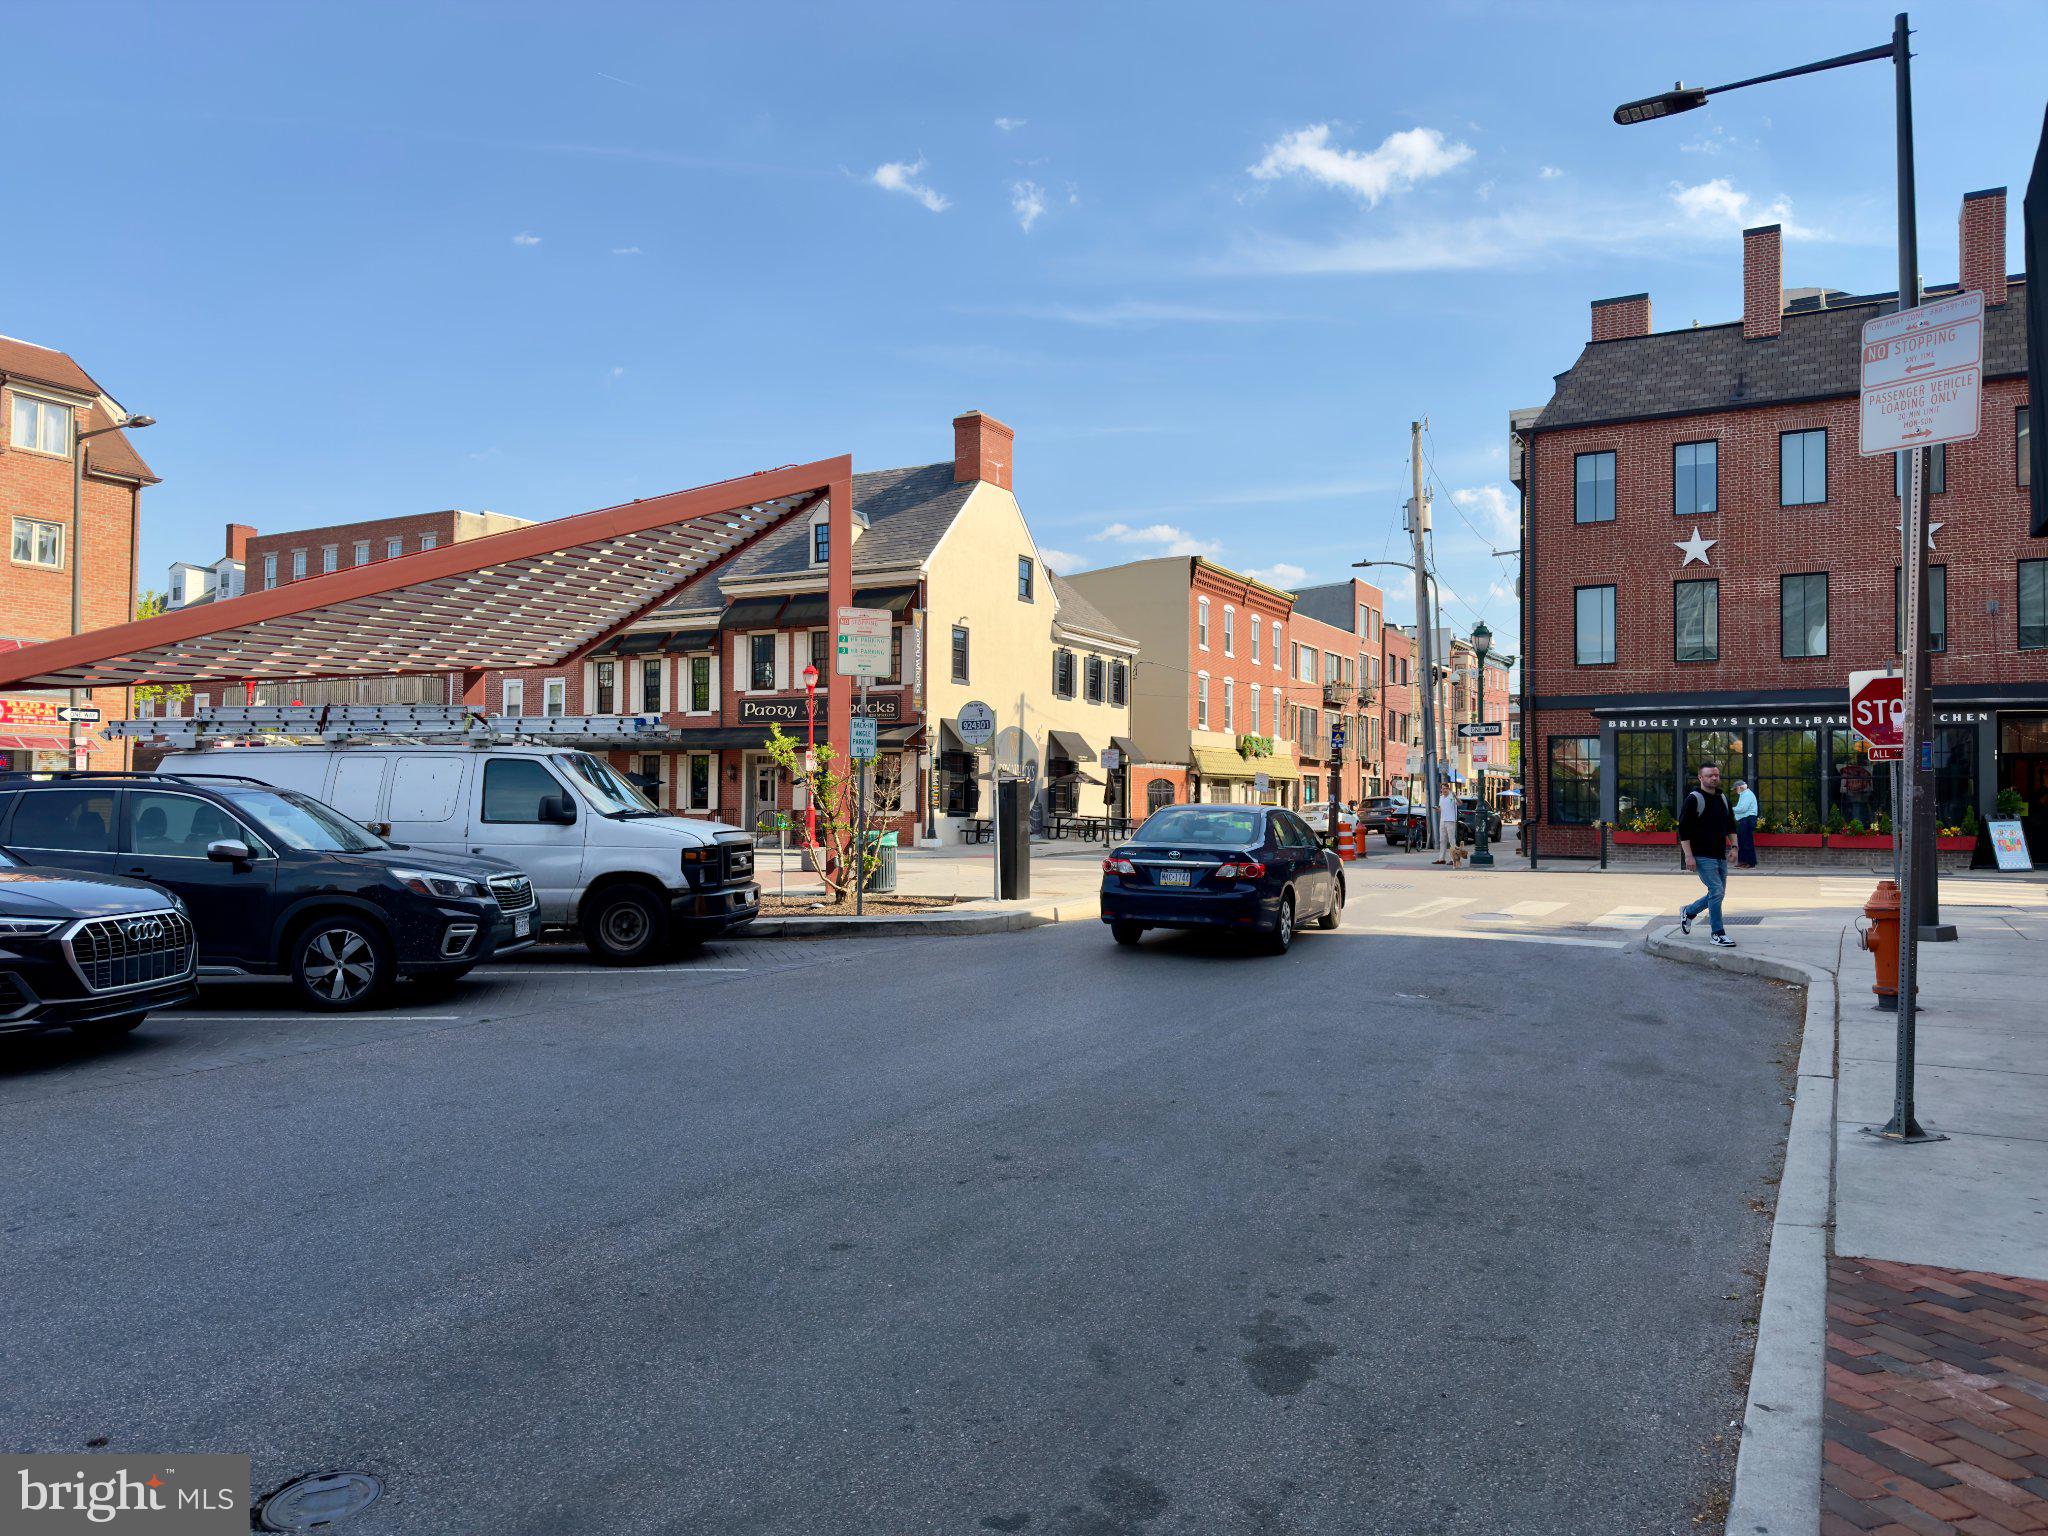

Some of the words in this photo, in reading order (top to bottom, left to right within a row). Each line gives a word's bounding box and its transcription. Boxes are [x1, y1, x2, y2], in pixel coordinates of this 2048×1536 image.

[1885, 317, 1904, 328] AWAY
[1906, 312, 1925, 322] ZONE
[1867, 346, 1886, 362] NO
[1894, 329, 1957, 355] STOPPING
[1904, 353, 1919, 364] ANY
[1920, 350, 1936, 361] TIME
[1869, 384, 1925, 406] PASSENGER
[1930, 373, 1973, 393] VEHICLE
[1881, 396, 1925, 415] LOADING
[1931, 389, 1959, 405] ONLY
[1908, 408, 1922, 418] MIN
[1923, 405, 1940, 416] LIMIT
[1903, 417, 1934, 429] MON-SUN
[1856, 698, 1905, 726] STO
[853, 721, 874, 729] BACK-IN
[963, 721, 990, 730] 924301
[1608, 718, 1680, 728] BRIDGET
[1689, 717, 1738, 727] FOY'S
[1748, 716, 1803, 726] LOCAL
[1813, 716, 1848, 724] BAR
[1933, 712, 1988, 722] CHEN
[855, 730, 872, 738] ANGLE
[852, 738, 874, 746] PARKING
[856, 746, 870, 754] ONLY
[1873, 750, 1890, 758] ALL
